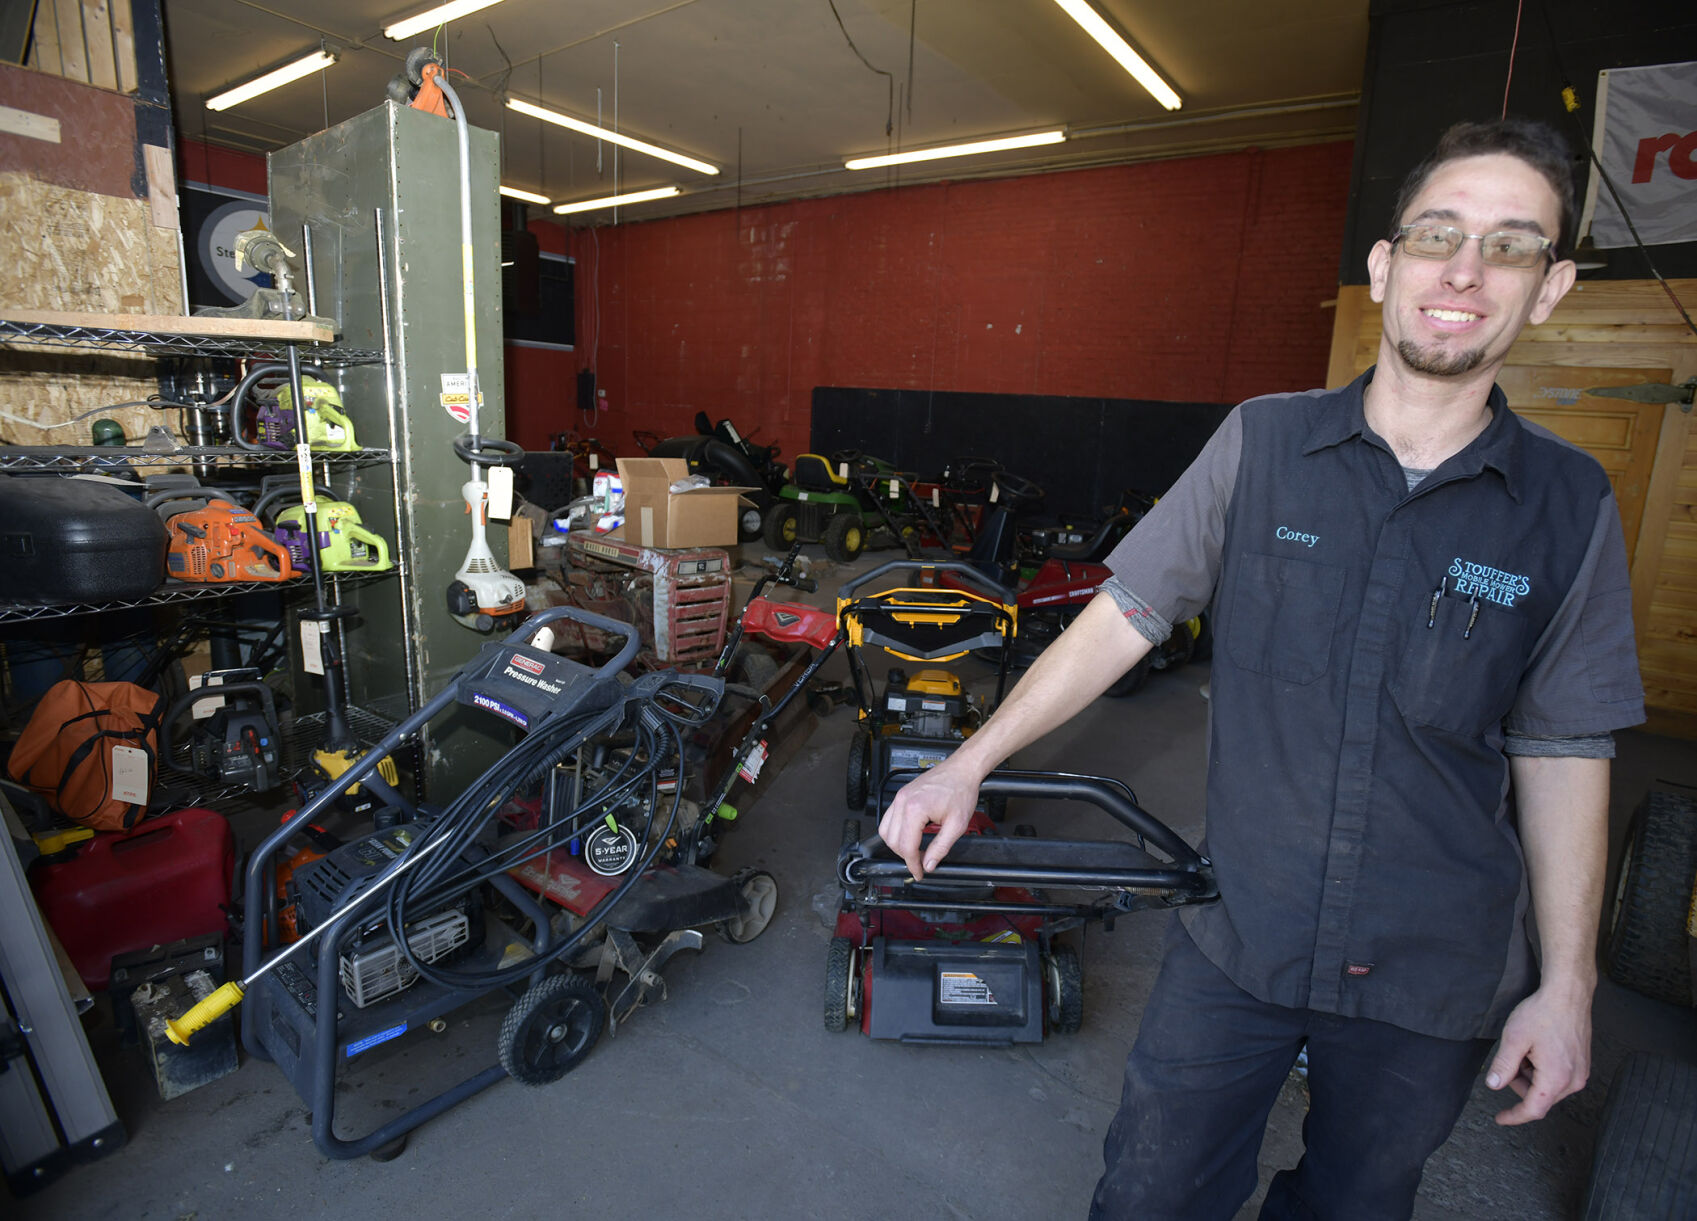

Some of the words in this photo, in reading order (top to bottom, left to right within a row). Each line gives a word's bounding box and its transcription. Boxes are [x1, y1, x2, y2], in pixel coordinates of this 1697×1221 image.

[1276, 526, 1320, 547] Corey
[1448, 557, 1530, 595] STOUFFER'S
[1461, 571, 1489, 586] MOBILE
[1490, 580, 1516, 594] MOWER
[1454, 578, 1515, 607] REPAIR
[503, 665, 538, 687] Pressure
[536, 679, 562, 695] Washer
[474, 694, 490, 708] 2100
[489, 700, 500, 711] PSI
[595, 845, 628, 856] 5-YEAR
